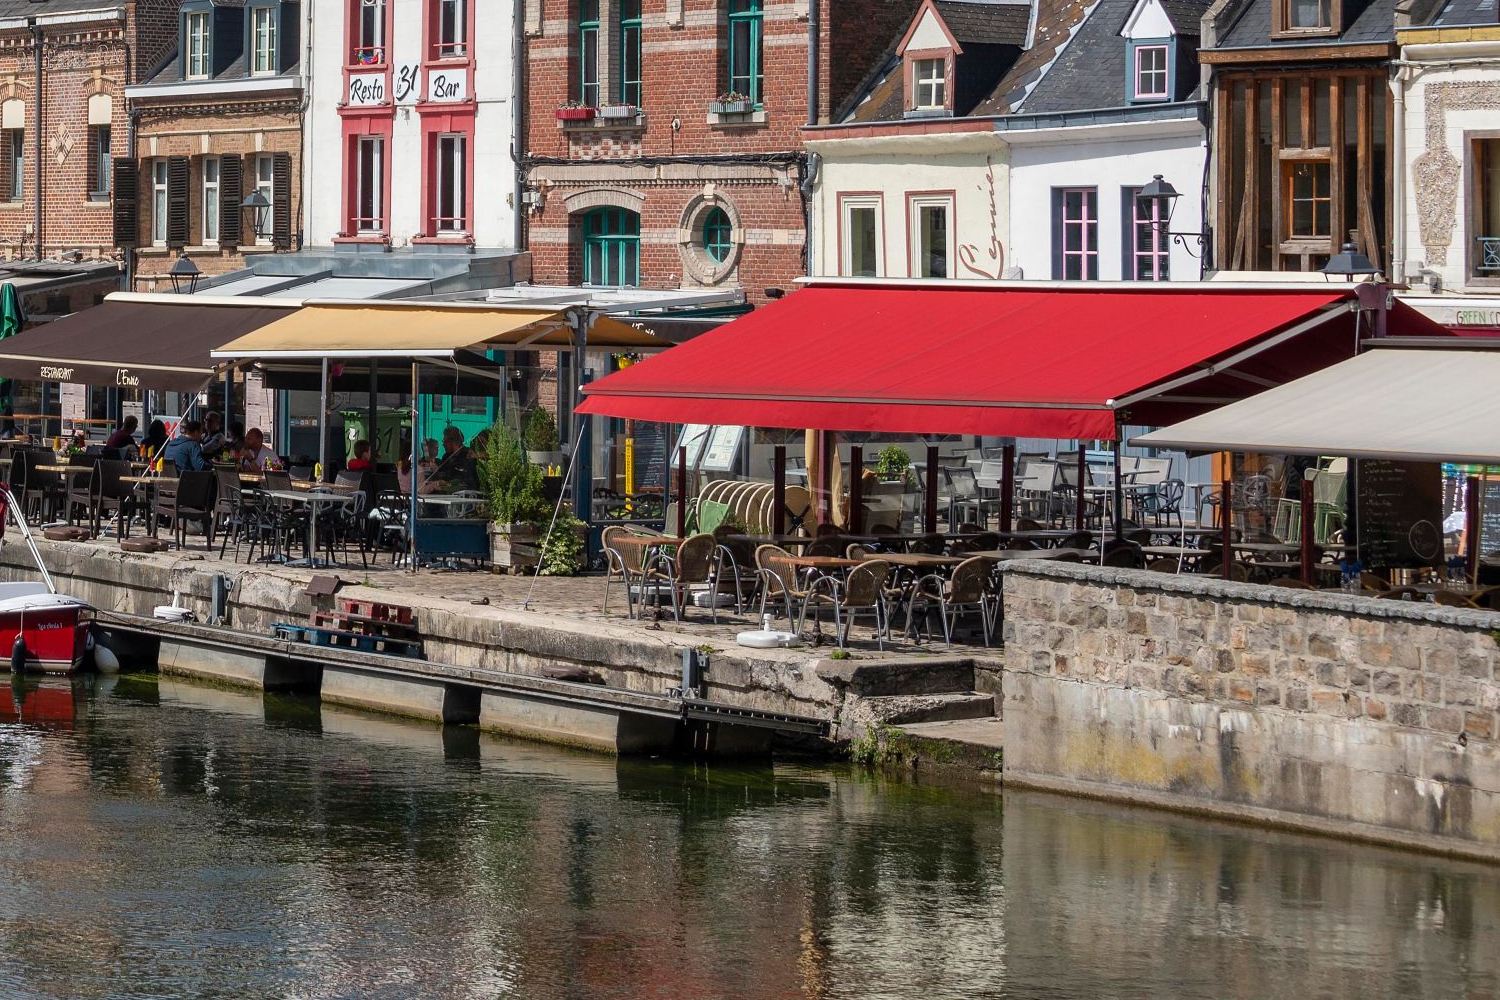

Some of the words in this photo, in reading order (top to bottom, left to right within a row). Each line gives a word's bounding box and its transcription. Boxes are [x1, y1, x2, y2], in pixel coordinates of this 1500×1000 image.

[350, 78, 383, 104] Resto
[395, 64, 419, 102] 31
[433, 74, 460, 98] Bar
[1456, 310, 1486, 326] GREEN
